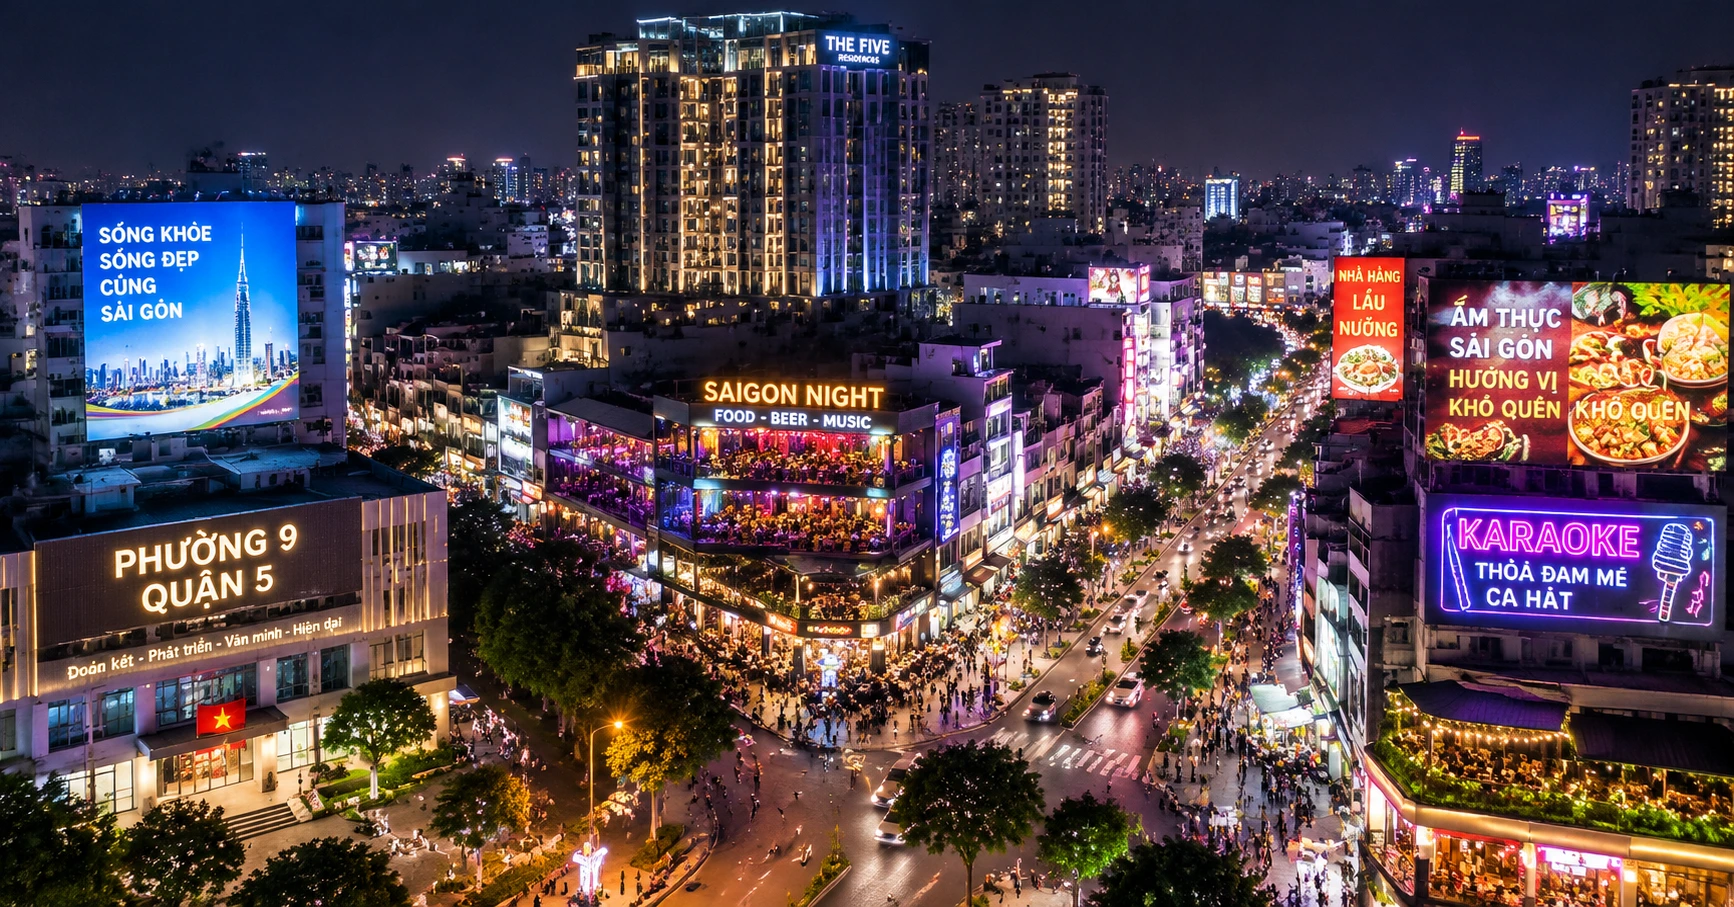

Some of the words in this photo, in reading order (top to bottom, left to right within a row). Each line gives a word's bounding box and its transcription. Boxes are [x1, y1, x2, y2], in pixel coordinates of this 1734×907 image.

[825, 35, 855, 52] THE
[859, 37, 890, 55] FIVE
[161, 250, 200, 272] ĐẸP
[1495, 307, 1562, 333] THỰC
[1536, 370, 1558, 394] VỊ
[704, 381, 797, 405] SAIGON
[806, 385, 885, 409] NIGHT
[714, 408, 756, 423] FOOD
[771, 411, 808, 426] BEER
[823, 414, 872, 429] MUSIC
[1458, 517, 1640, 558] KARAOKE
[114, 529, 267, 579] PHƯỜNG
[279, 524, 297, 552] 9
[1541, 565, 1589, 585] ĐAM
[142, 569, 243, 615] QUẬN
[255, 564, 274, 592] 5
[1486, 587, 1518, 607] CA
[252, 626, 282, 645] minh
